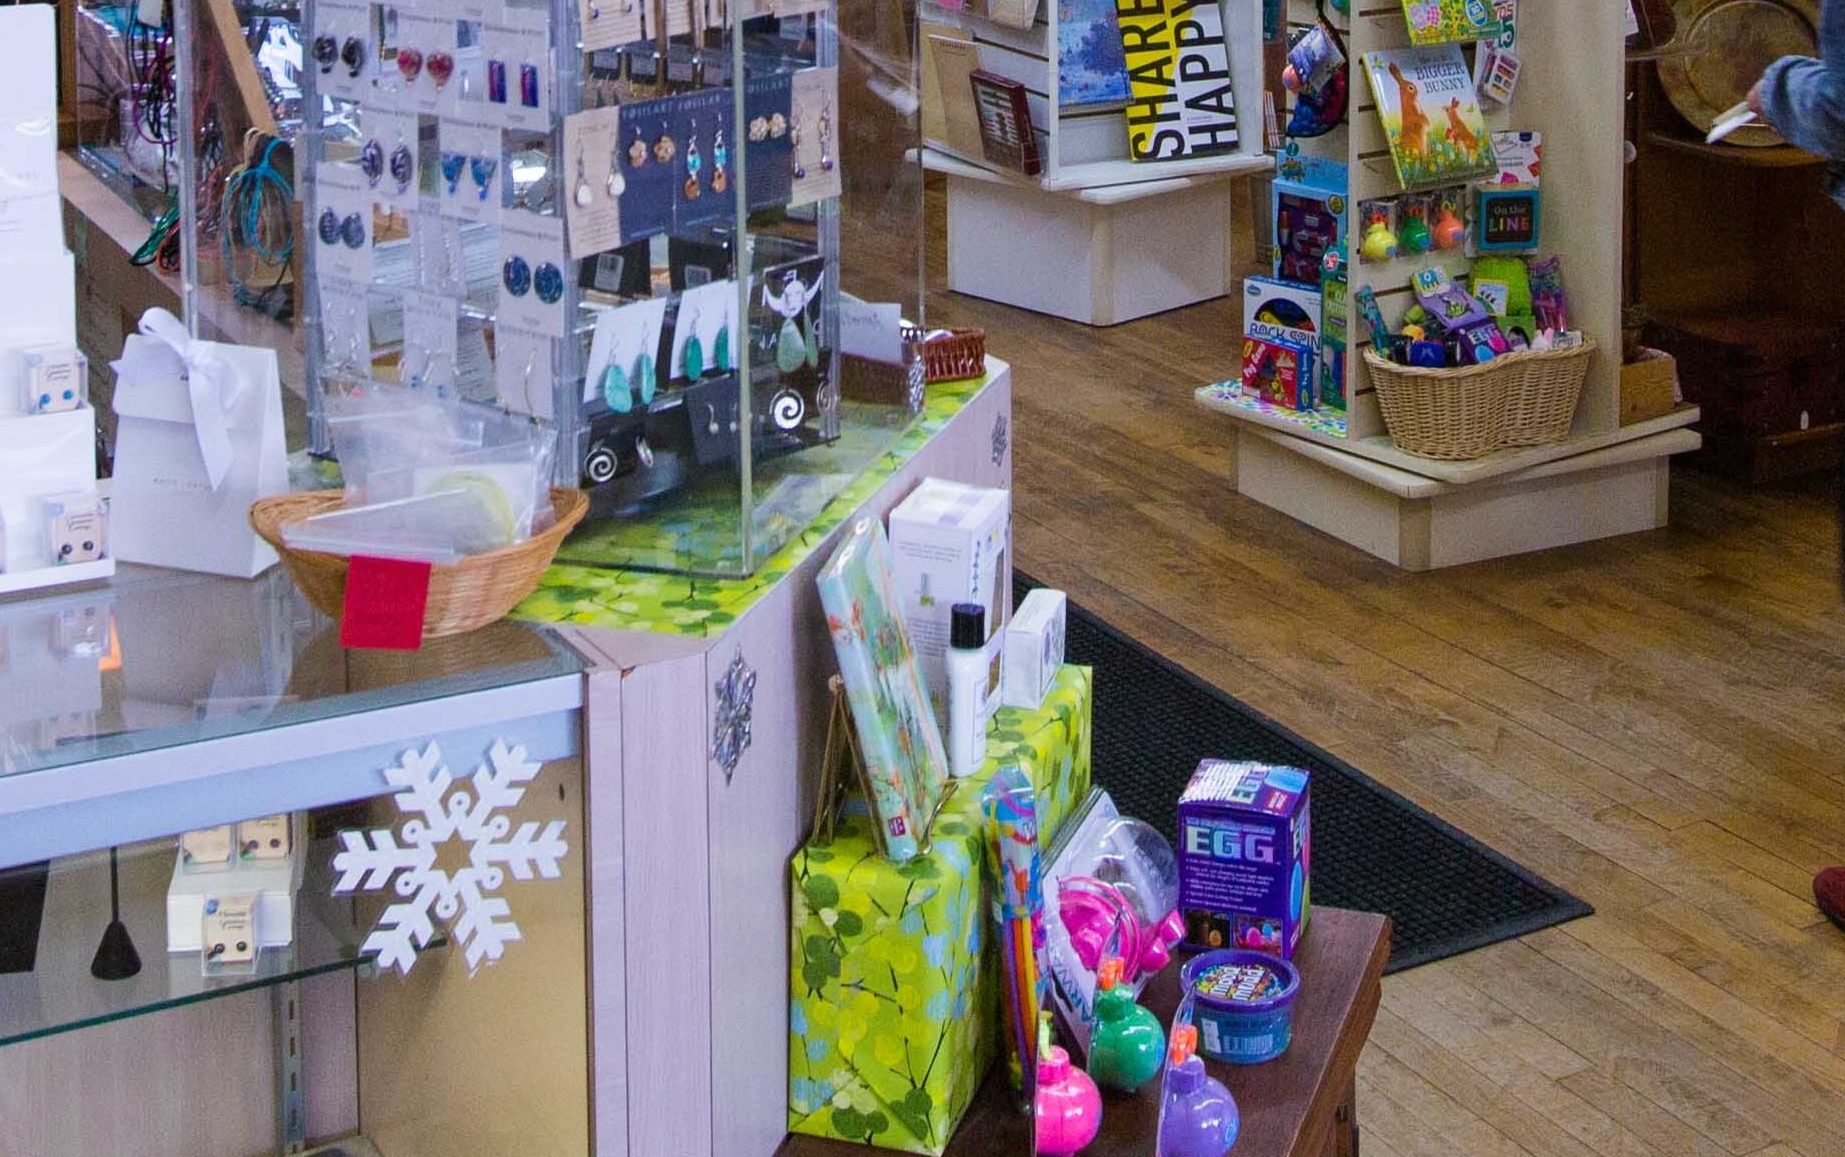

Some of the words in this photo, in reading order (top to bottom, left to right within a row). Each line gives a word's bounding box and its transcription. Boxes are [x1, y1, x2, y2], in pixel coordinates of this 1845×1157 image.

[1415, 61, 1467, 81] BIGGER
[1424, 76, 1468, 94] BUNNY
[1487, 215, 1531, 234] LINE
[1186, 825, 1274, 864] EGG
